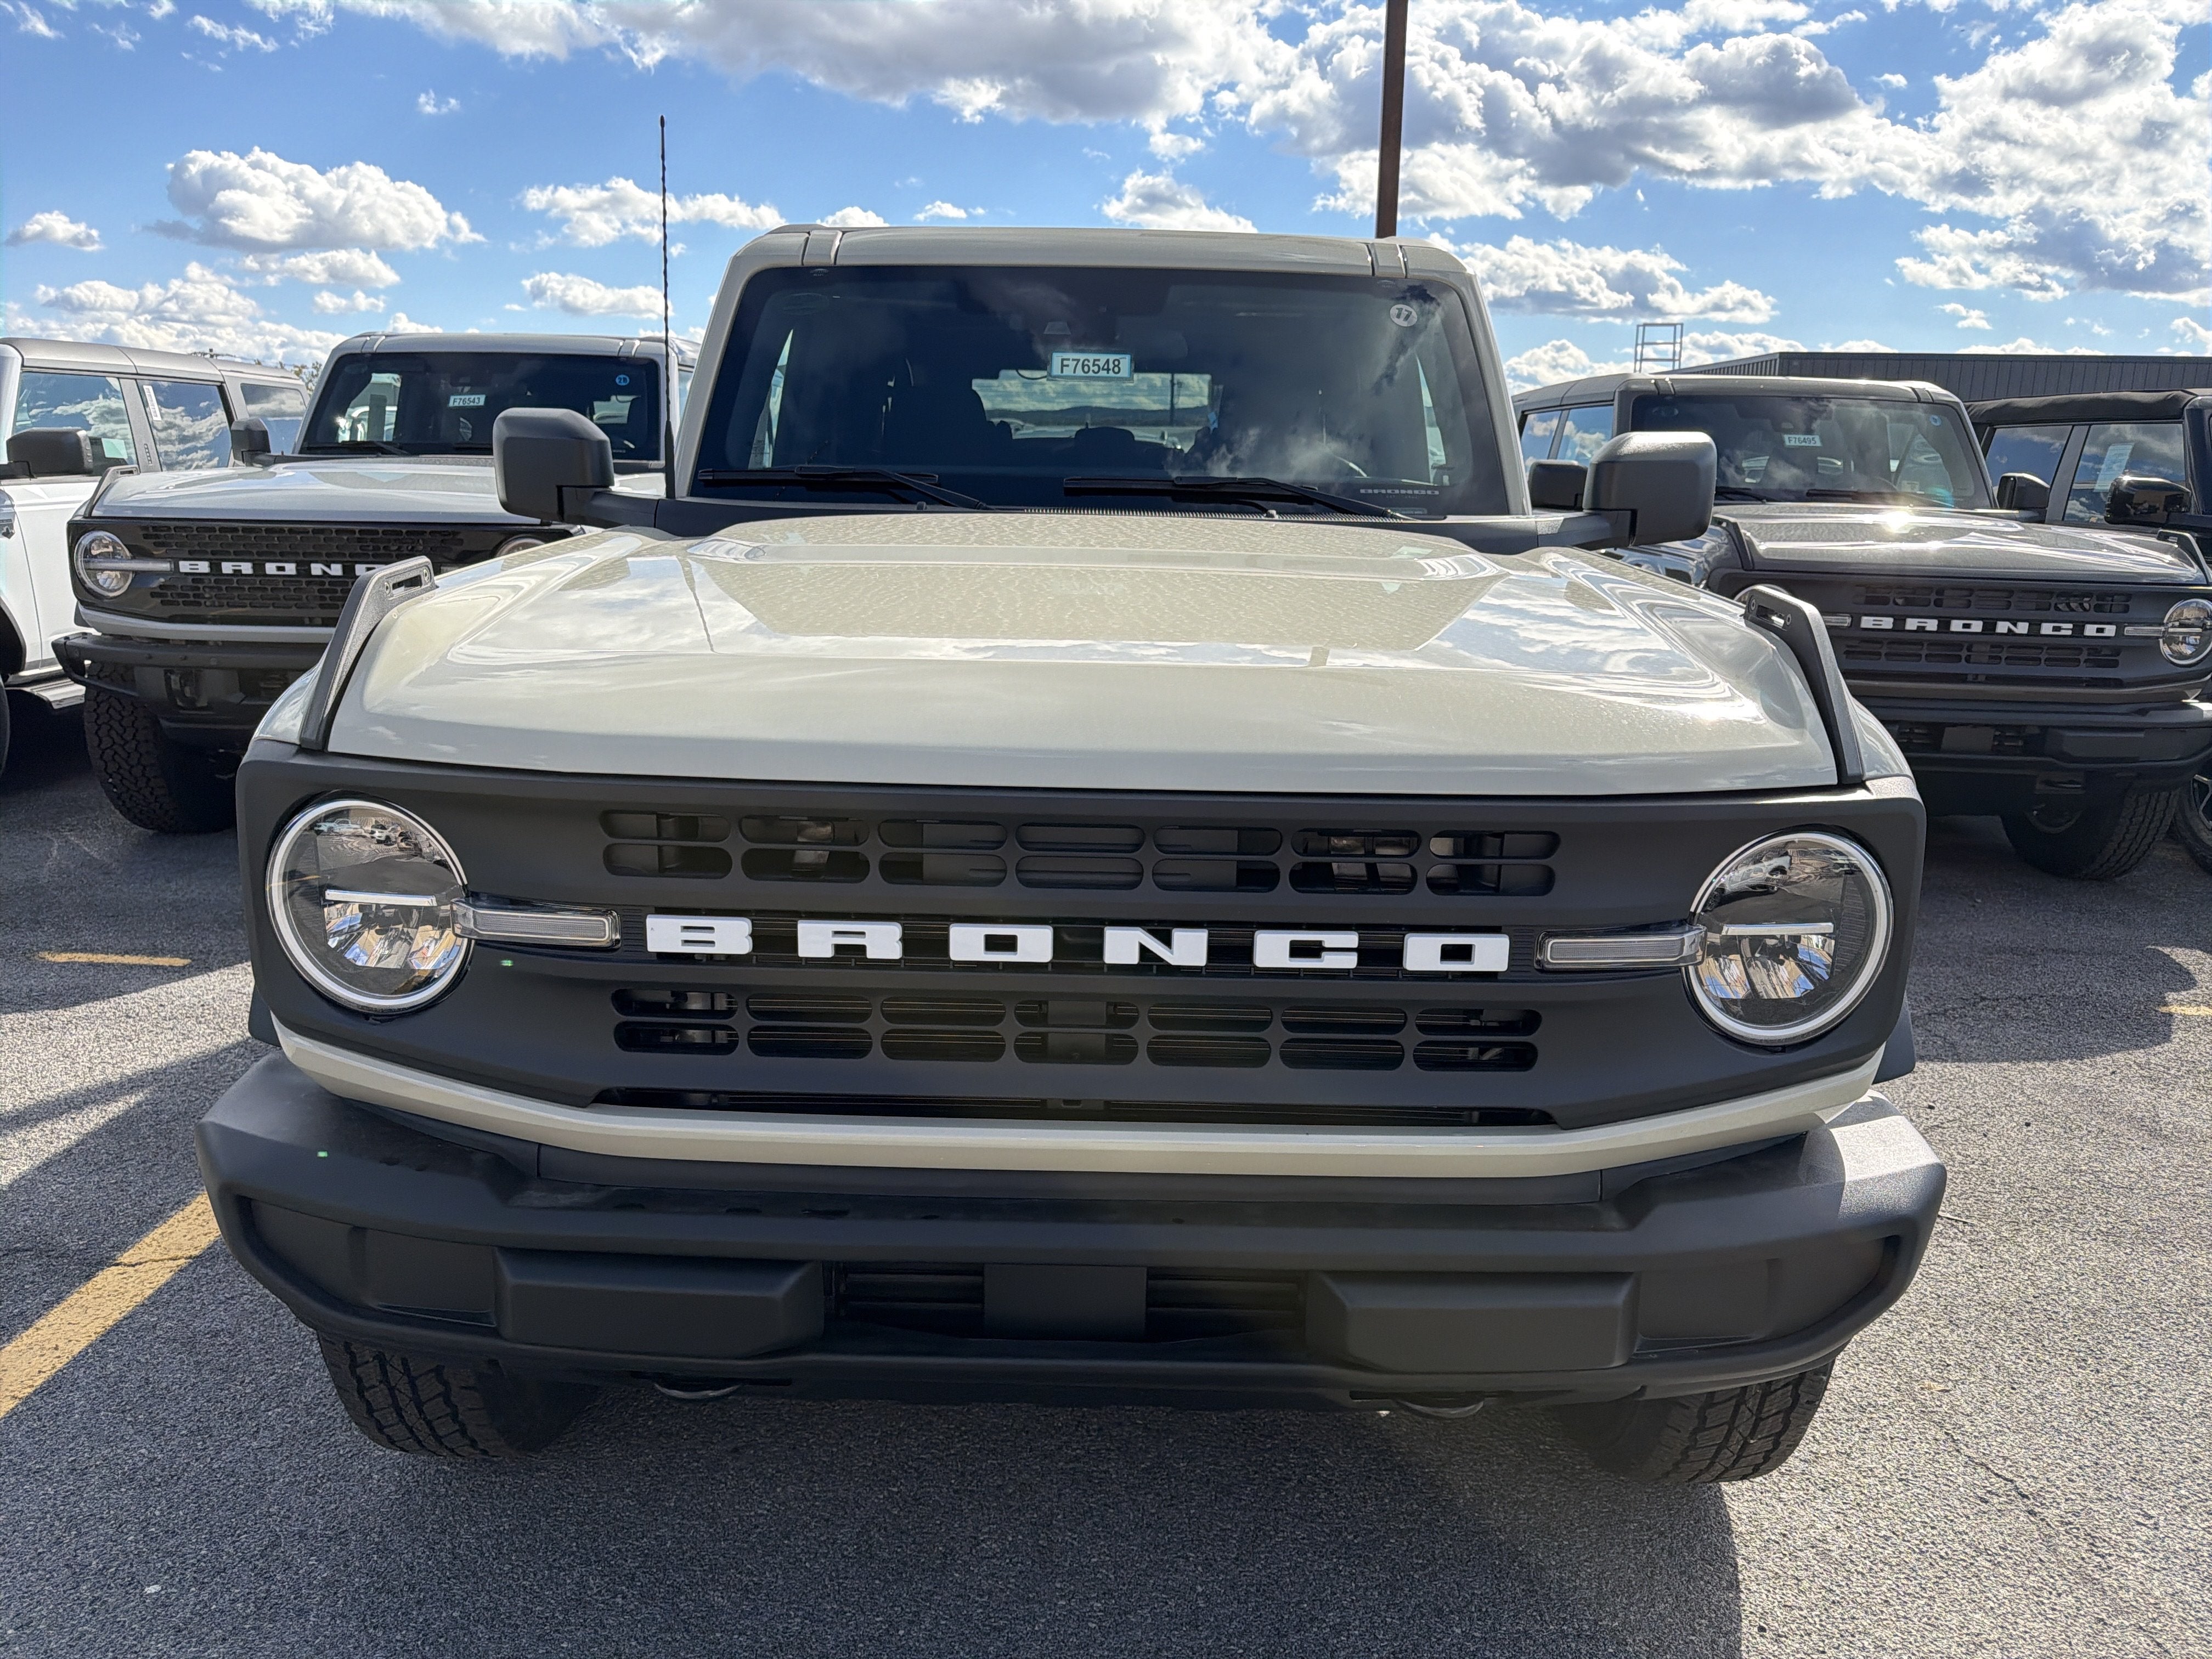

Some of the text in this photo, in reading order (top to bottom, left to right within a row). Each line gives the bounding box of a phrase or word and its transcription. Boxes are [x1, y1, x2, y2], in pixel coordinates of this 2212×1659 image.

[1060, 358, 1121, 375] F76548
[179, 561, 386, 576] BRONC
[1860, 616, 2117, 636] BRONCO
[646, 914, 1509, 972] BRONCO
